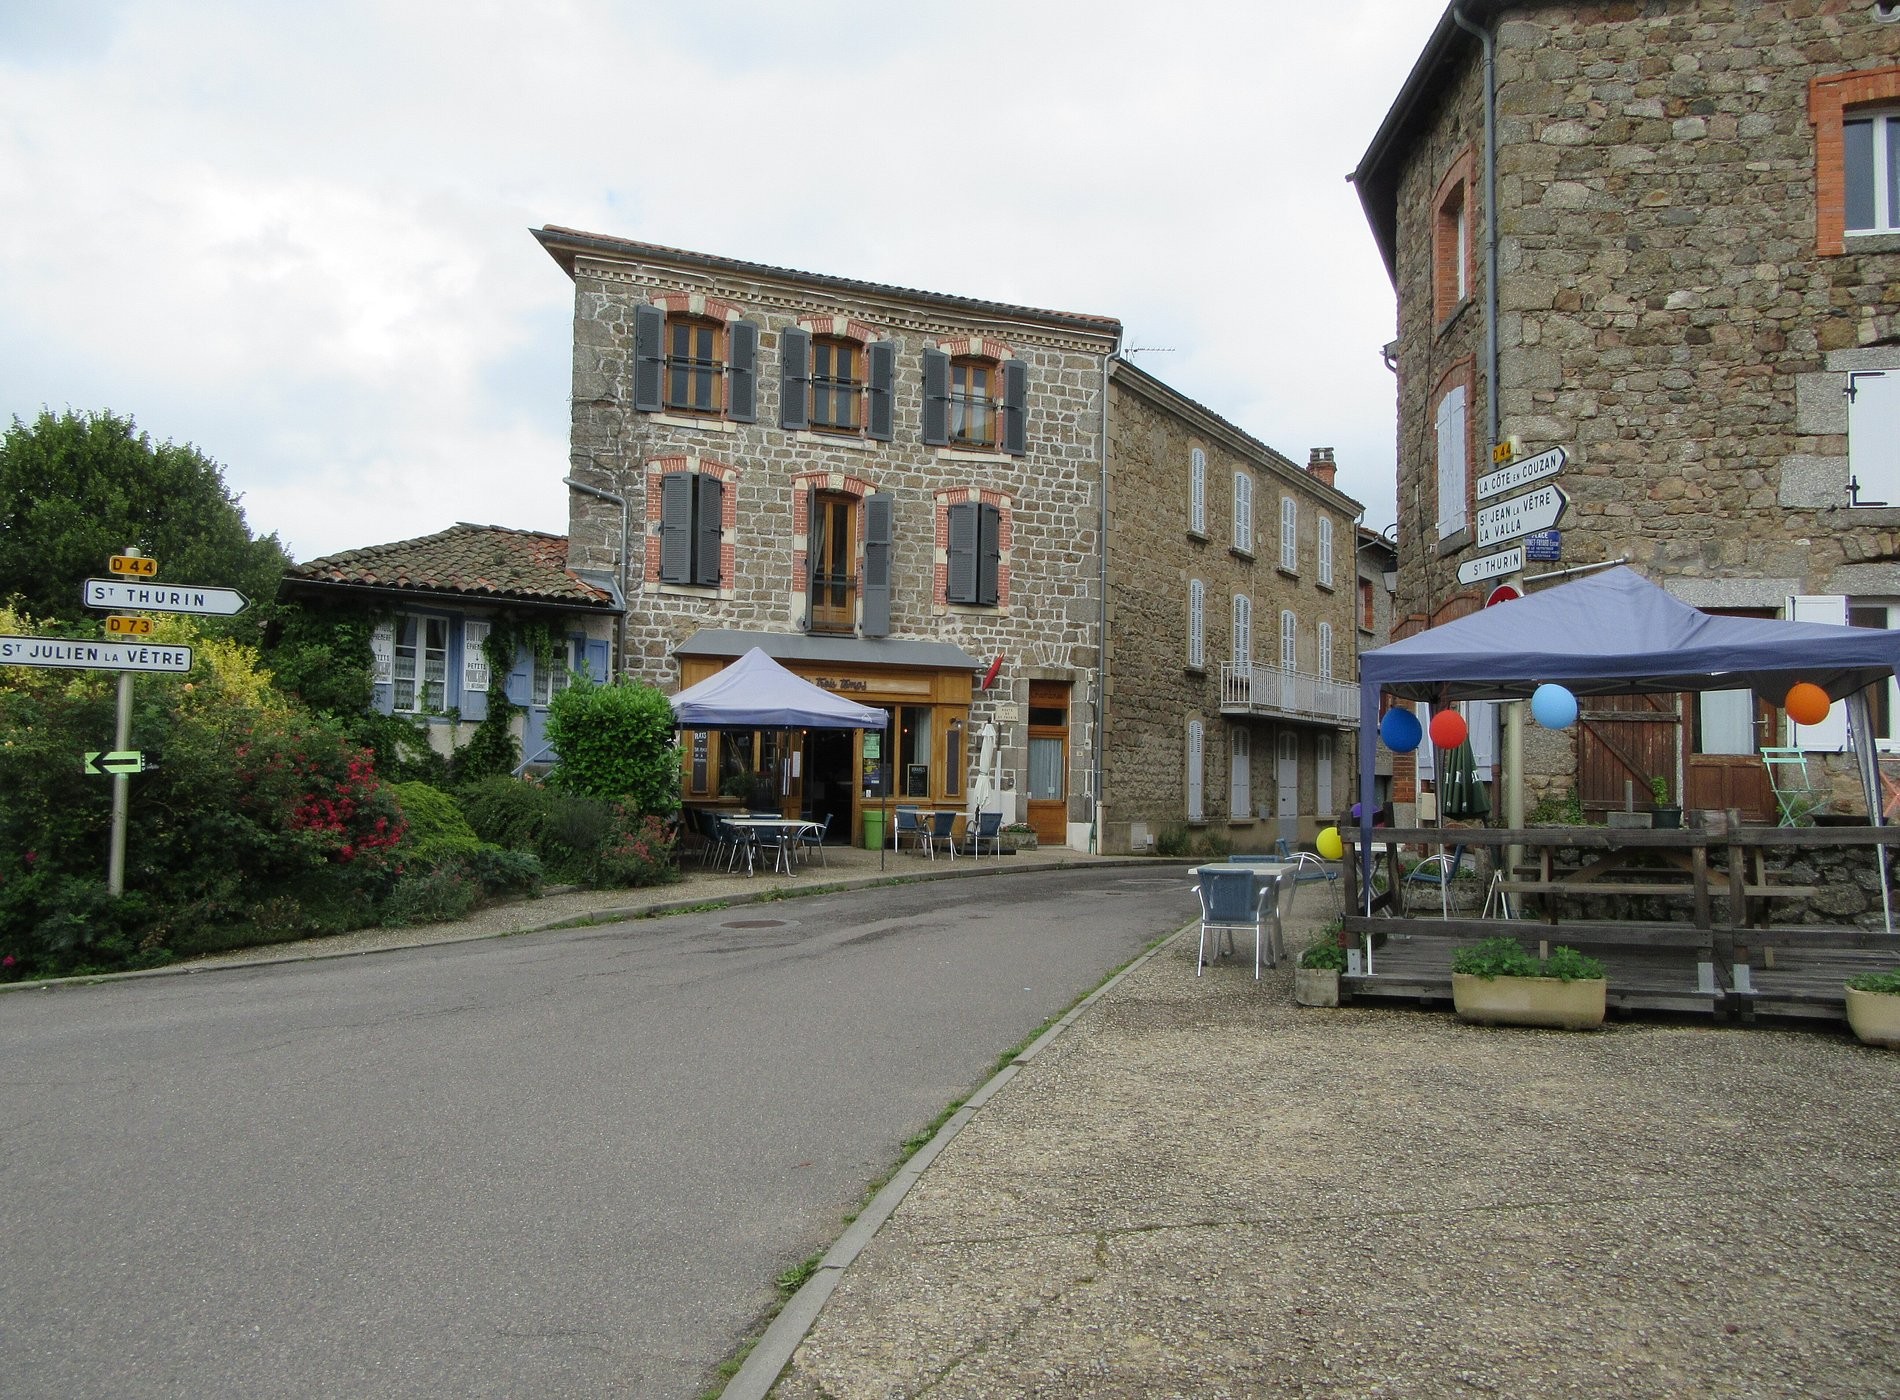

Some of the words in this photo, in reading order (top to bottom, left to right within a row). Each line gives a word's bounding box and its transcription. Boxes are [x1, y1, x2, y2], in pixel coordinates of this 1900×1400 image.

[1493, 449, 1498, 461] D
[1500, 443, 1512, 457] 44
[1479, 481, 1488, 494] LA
[1491, 473, 1511, 490] CÔTE
[1513, 473, 1520, 482] EN
[1523, 455, 1556, 477] COUZAN
[1490, 505, 1511, 523] JEAN
[1513, 507, 1520, 516] LA
[1523, 491, 1551, 512] VÊTRE
[1479, 529, 1490, 542] LA
[1494, 519, 1521, 537] VALLA
[113, 558, 123, 571] D
[129, 560, 154, 573] 44
[1485, 553, 1519, 572] THURIN
[127, 589, 205, 606] THURIN
[110, 619, 120, 632] D
[129, 620, 150, 633] 73
[29, 645, 98, 661] JULIEN
[104, 653, 119, 662] LA
[127, 649, 184, 665] VÊTRE
